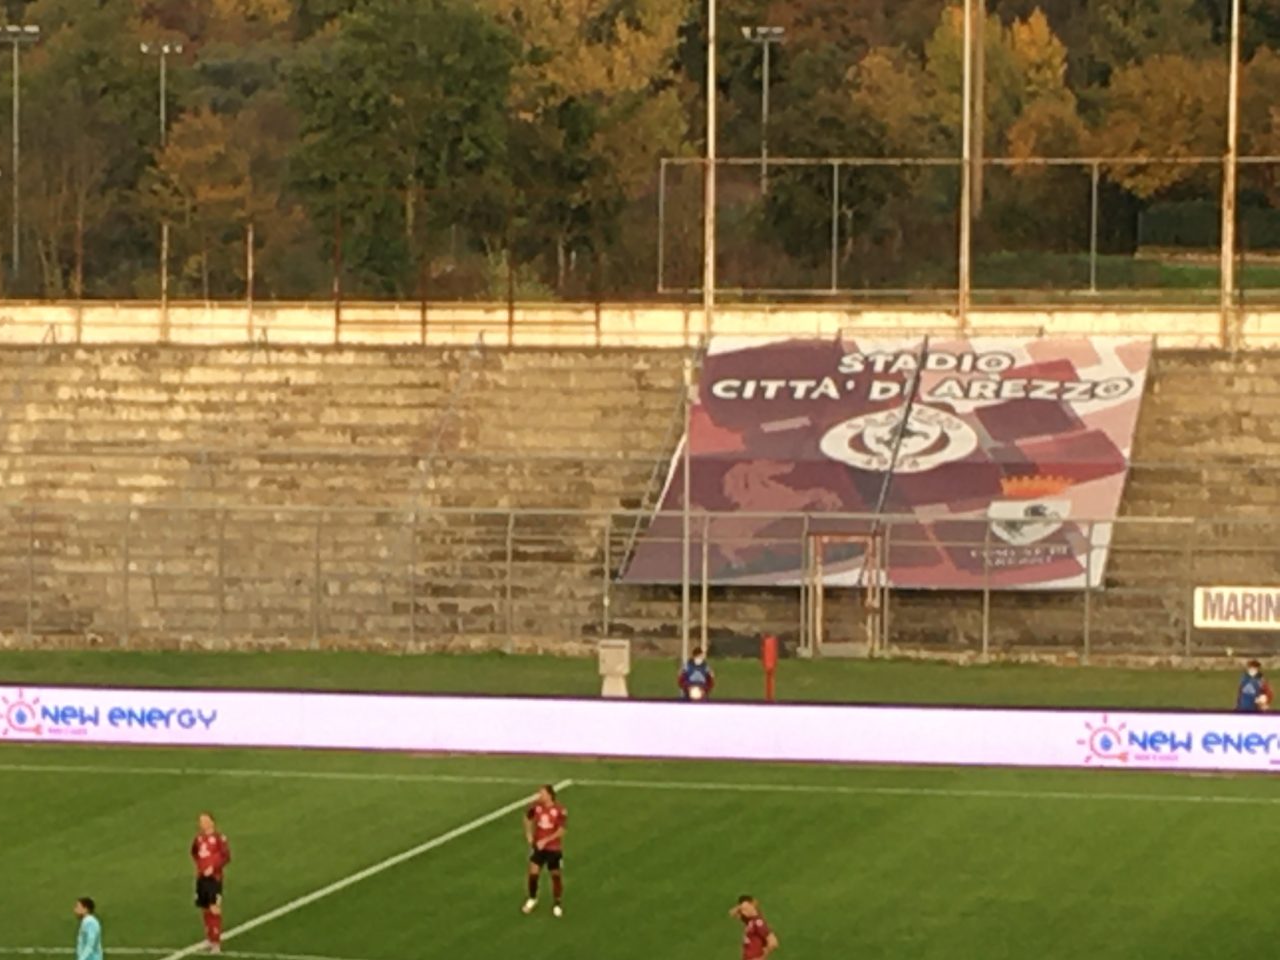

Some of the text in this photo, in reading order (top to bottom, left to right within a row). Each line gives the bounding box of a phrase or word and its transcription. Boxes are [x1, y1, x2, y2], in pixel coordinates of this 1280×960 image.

[838, 350, 1017, 374] STADIO
[928, 376, 1136, 402] AREZZO
[1202, 591, 1280, 623] MARIN
